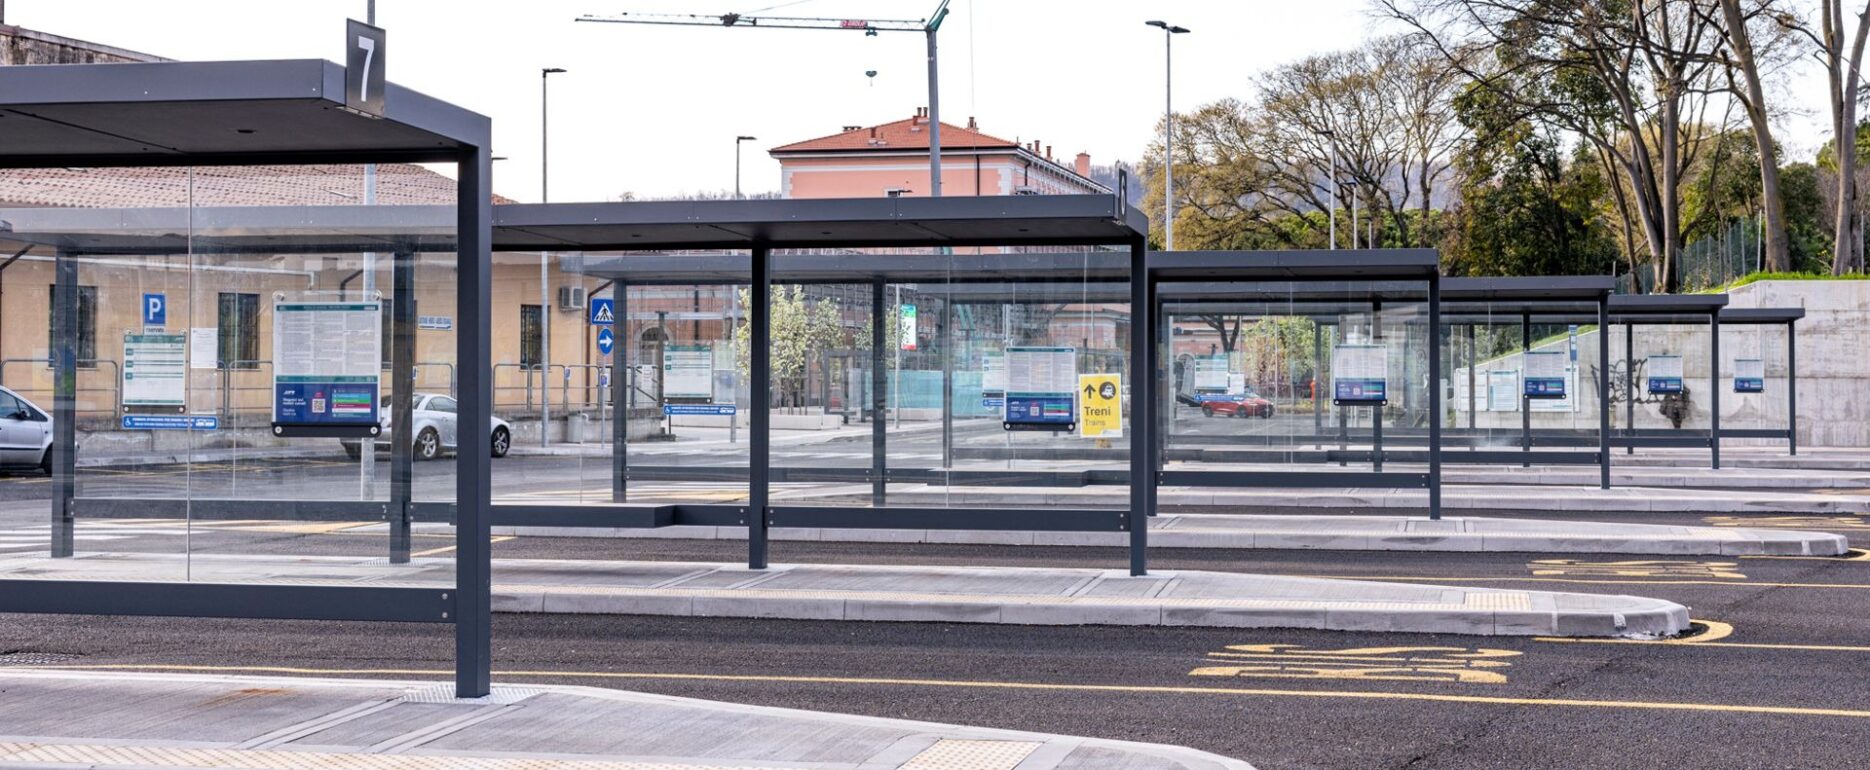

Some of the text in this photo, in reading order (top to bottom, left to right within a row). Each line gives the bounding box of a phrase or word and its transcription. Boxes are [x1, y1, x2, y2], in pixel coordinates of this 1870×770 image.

[358, 35, 375, 102] 7
[148, 298, 161, 320] P
[1084, 406, 1111, 416] Treni
[1188, 644, 1524, 684] BUS
